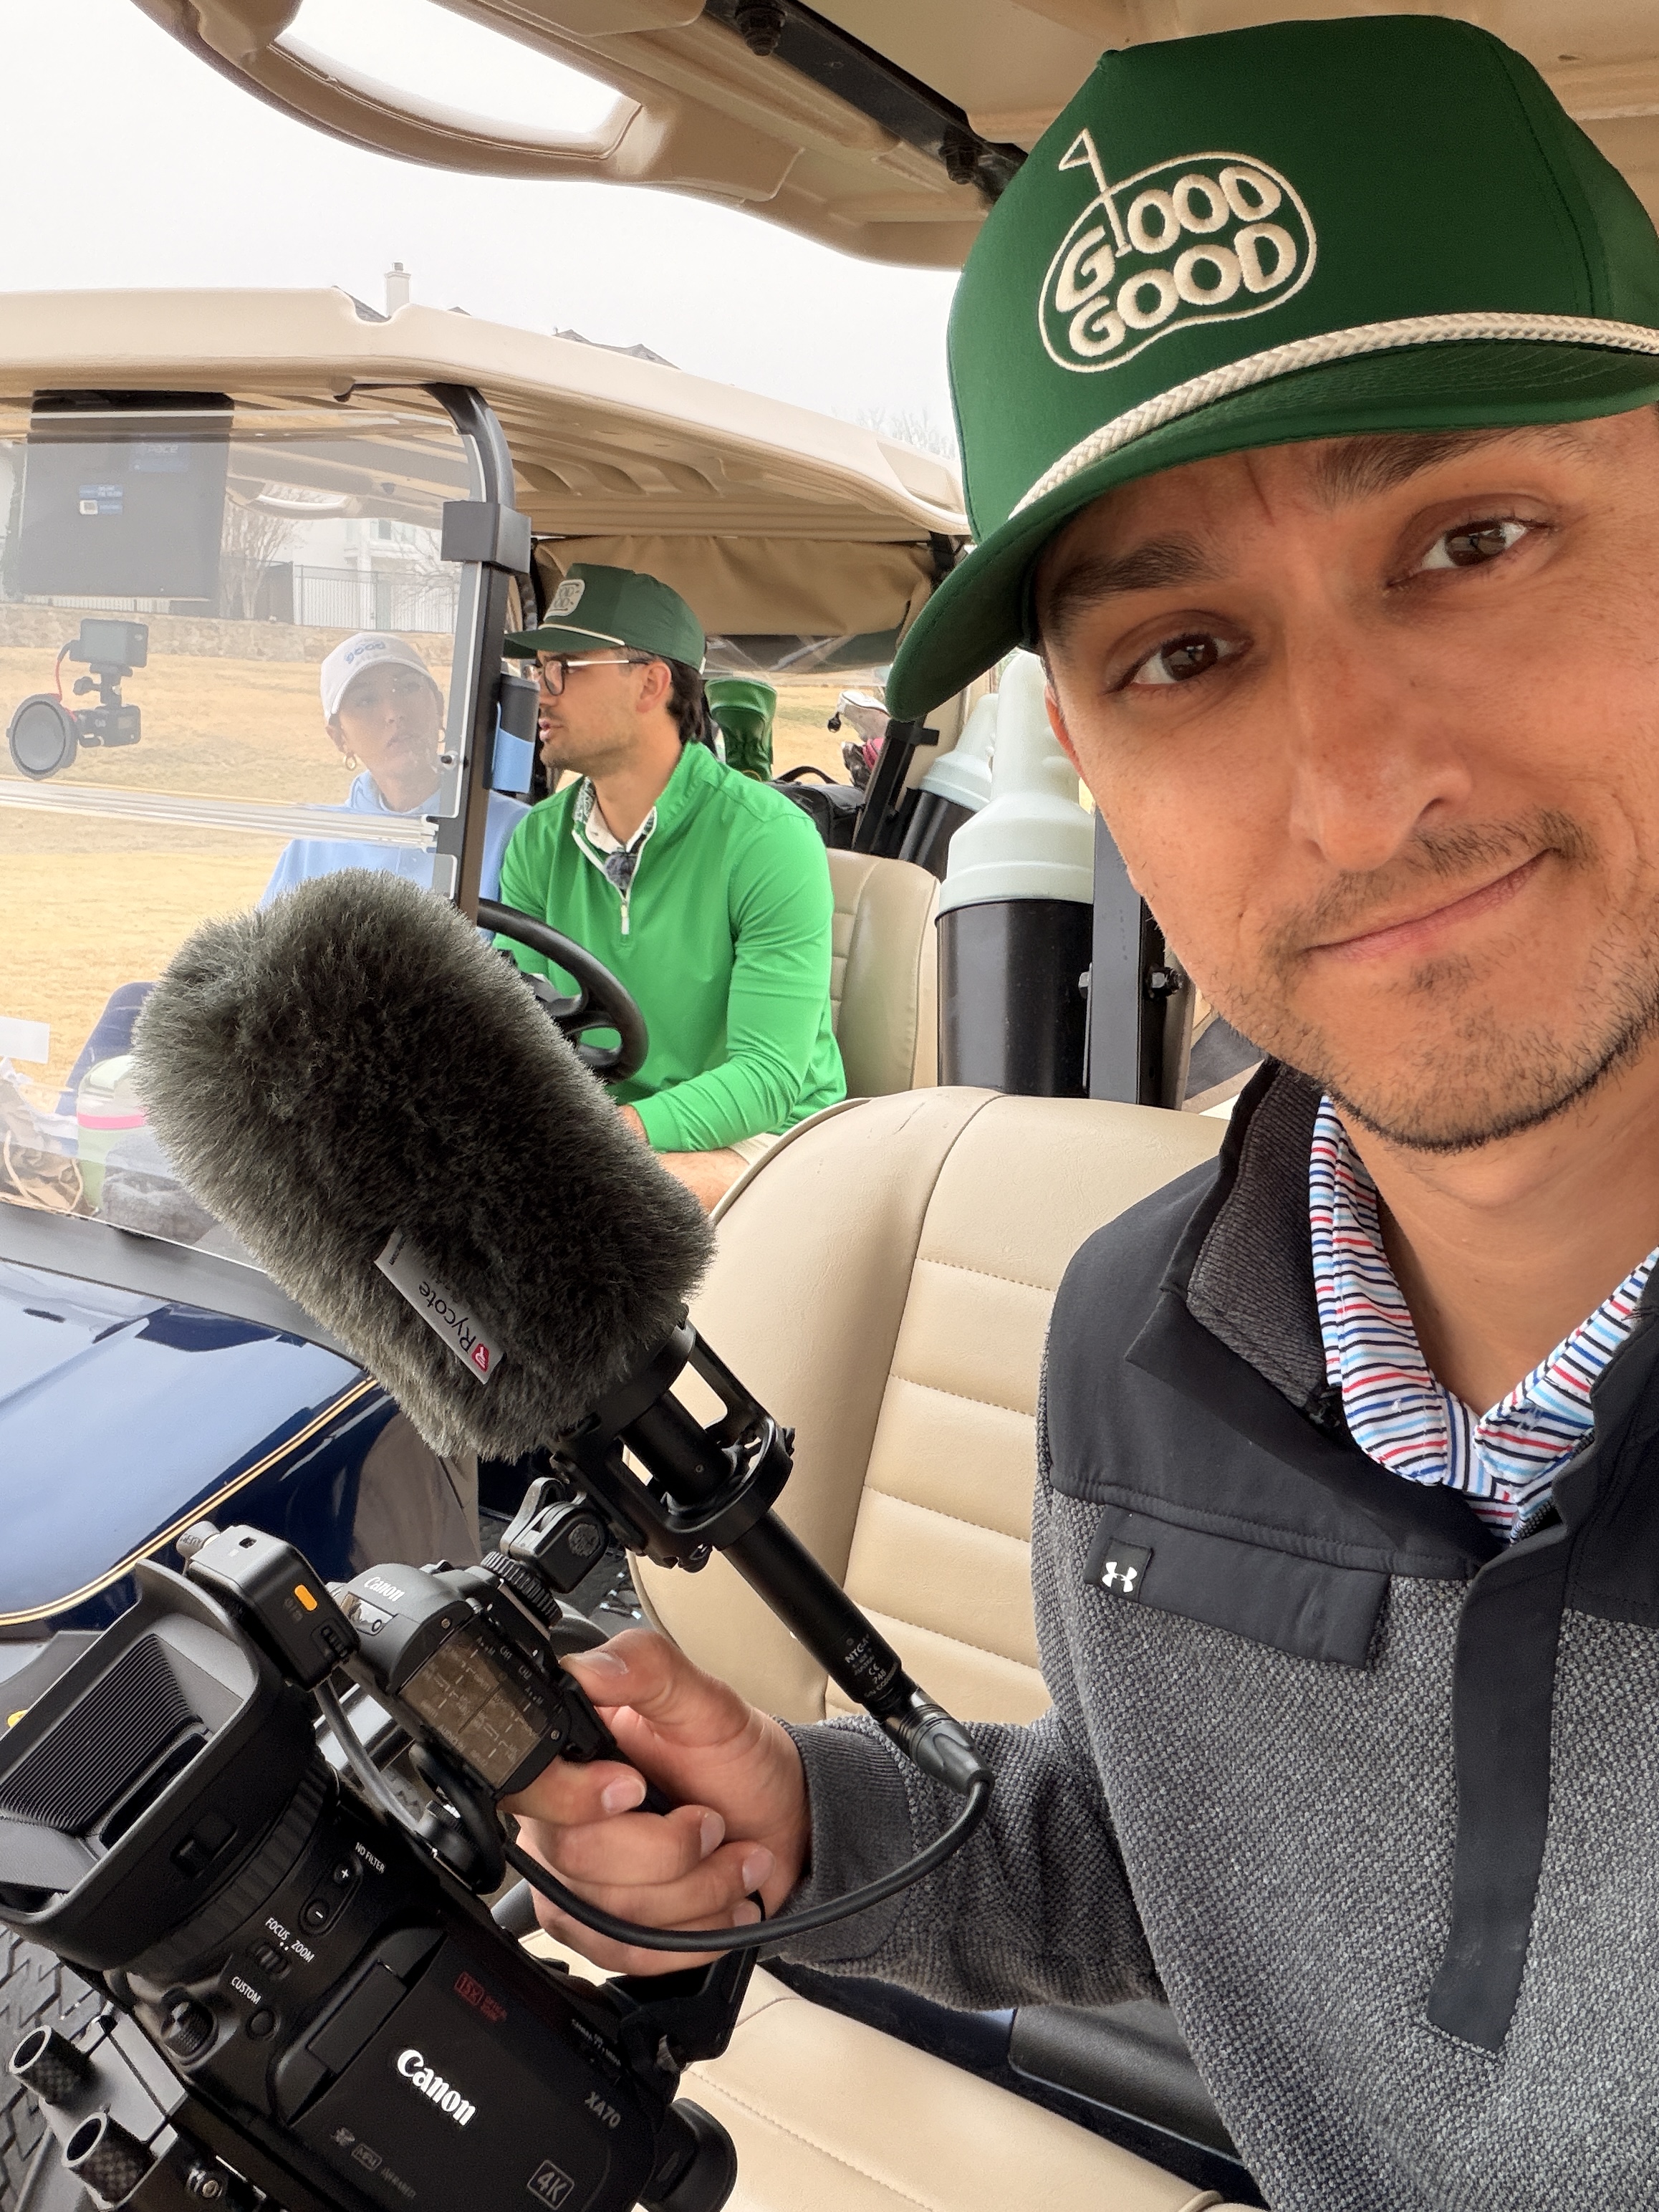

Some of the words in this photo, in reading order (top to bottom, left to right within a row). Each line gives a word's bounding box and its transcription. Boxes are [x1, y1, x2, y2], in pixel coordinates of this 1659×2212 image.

[1056, 165, 1282, 312] GOOD
[1069, 223, 1297, 357] GOOD
[418, 1281, 477, 1353] Rycote
[364, 1576, 405, 1602] Canon
[365, 1850, 386, 1874] FILTER
[265, 1917, 290, 1941] FOCUS
[291, 1939, 315, 1963] ZOOM
[231, 1976, 261, 2005] CUSTOM
[397, 2049, 476, 2126] Canon
[584, 2091, 621, 2128] XA70
[537, 2171, 568, 2202] 4K
